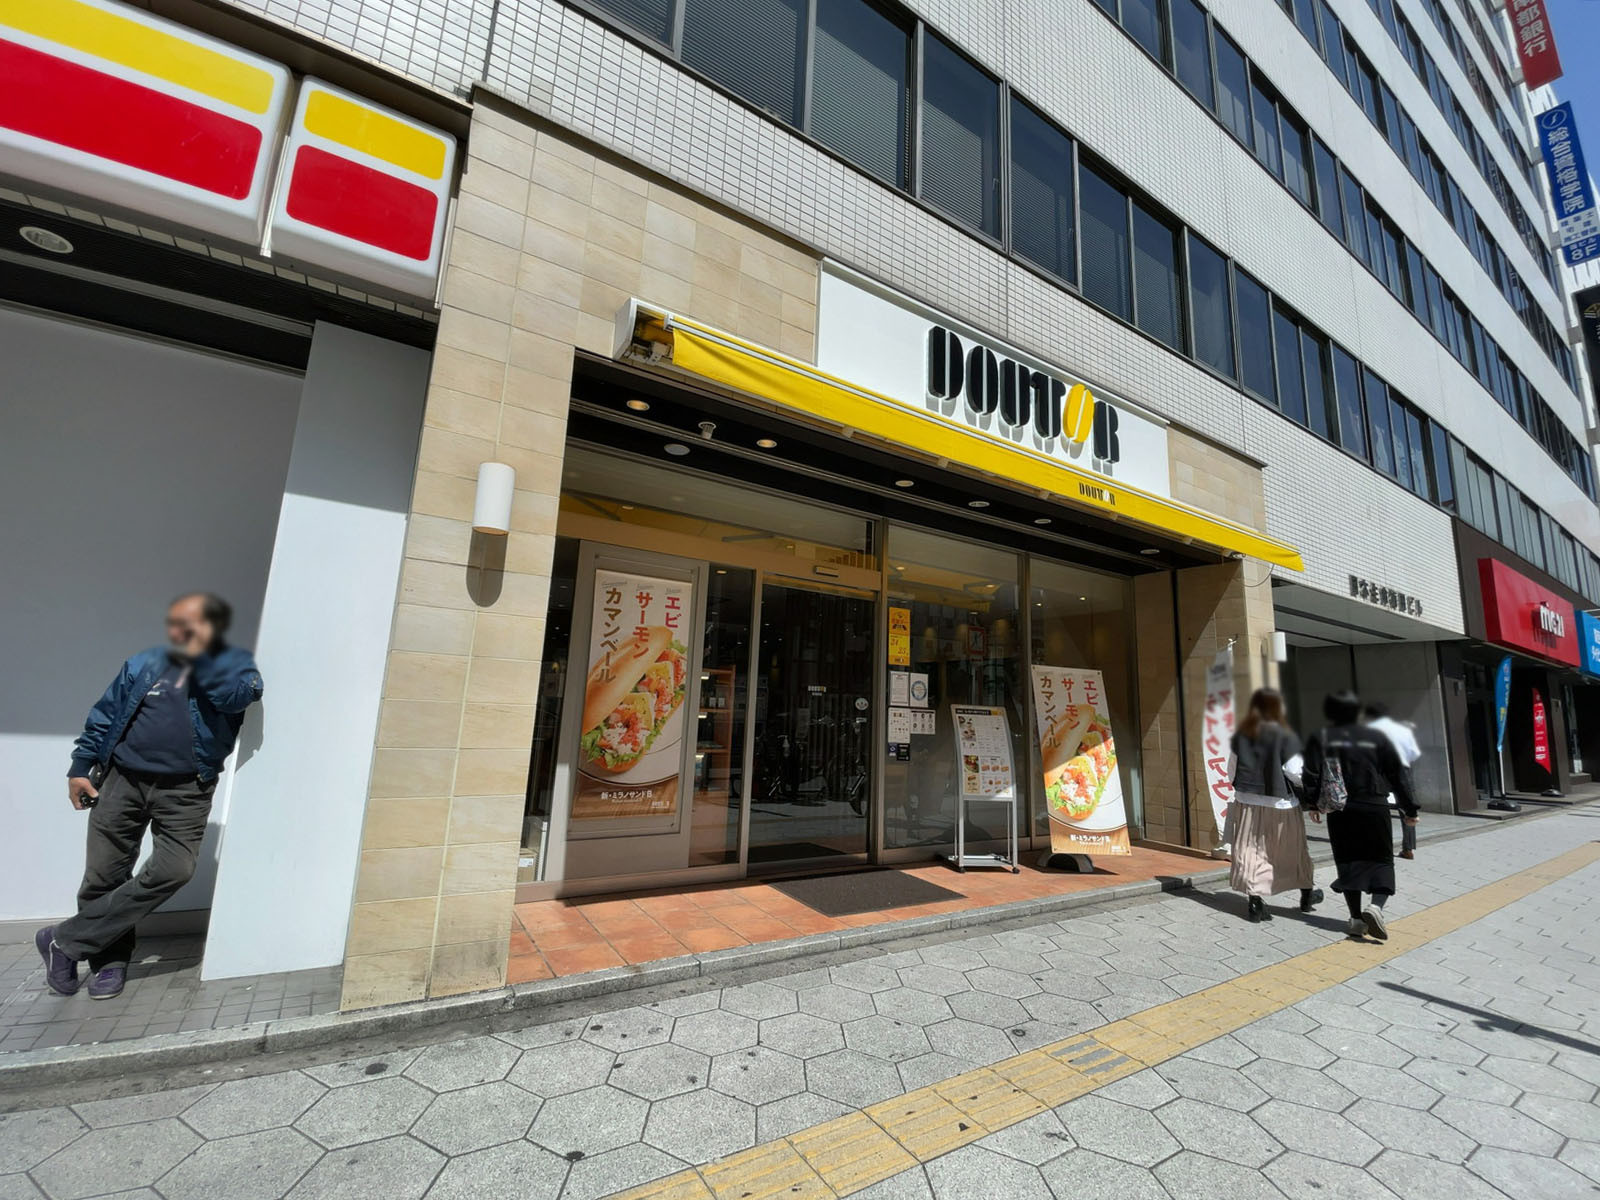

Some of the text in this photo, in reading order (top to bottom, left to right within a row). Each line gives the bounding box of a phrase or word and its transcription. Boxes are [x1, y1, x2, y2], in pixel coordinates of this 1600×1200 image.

[928, 326, 1119, 464] DOUTOR
[1079, 482, 1116, 506] DOUTOR
[600, 587, 623, 684] カマンベール
[632, 591, 653, 659] サーモン
[664, 596, 681, 629] エビ
[1040, 675, 1061, 749] カマンベール
[1061, 677, 1081, 730] サーモン
[1083, 680, 1098, 706] エビ
